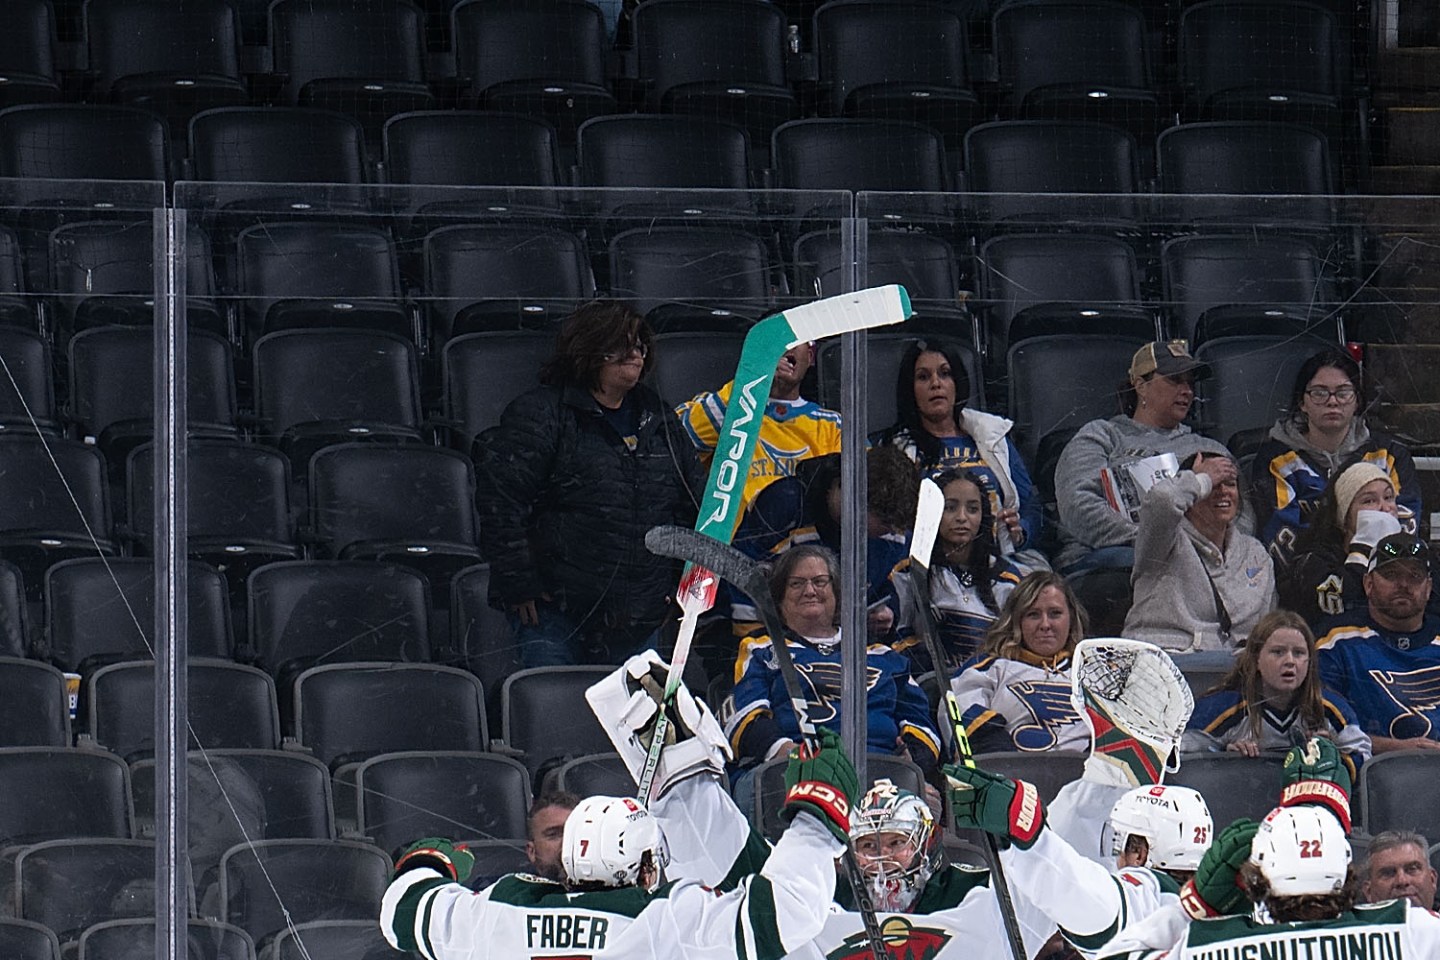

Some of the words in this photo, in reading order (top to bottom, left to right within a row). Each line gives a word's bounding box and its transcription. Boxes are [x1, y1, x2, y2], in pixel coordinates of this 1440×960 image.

[699, 374, 768, 532] VAPOR
[789, 782, 850, 818] CCM
[580, 840, 590, 857] 7
[1194, 826, 1207, 844] 25
[1300, 840, 1322, 859] 22
[526, 914, 609, 950] FABER
